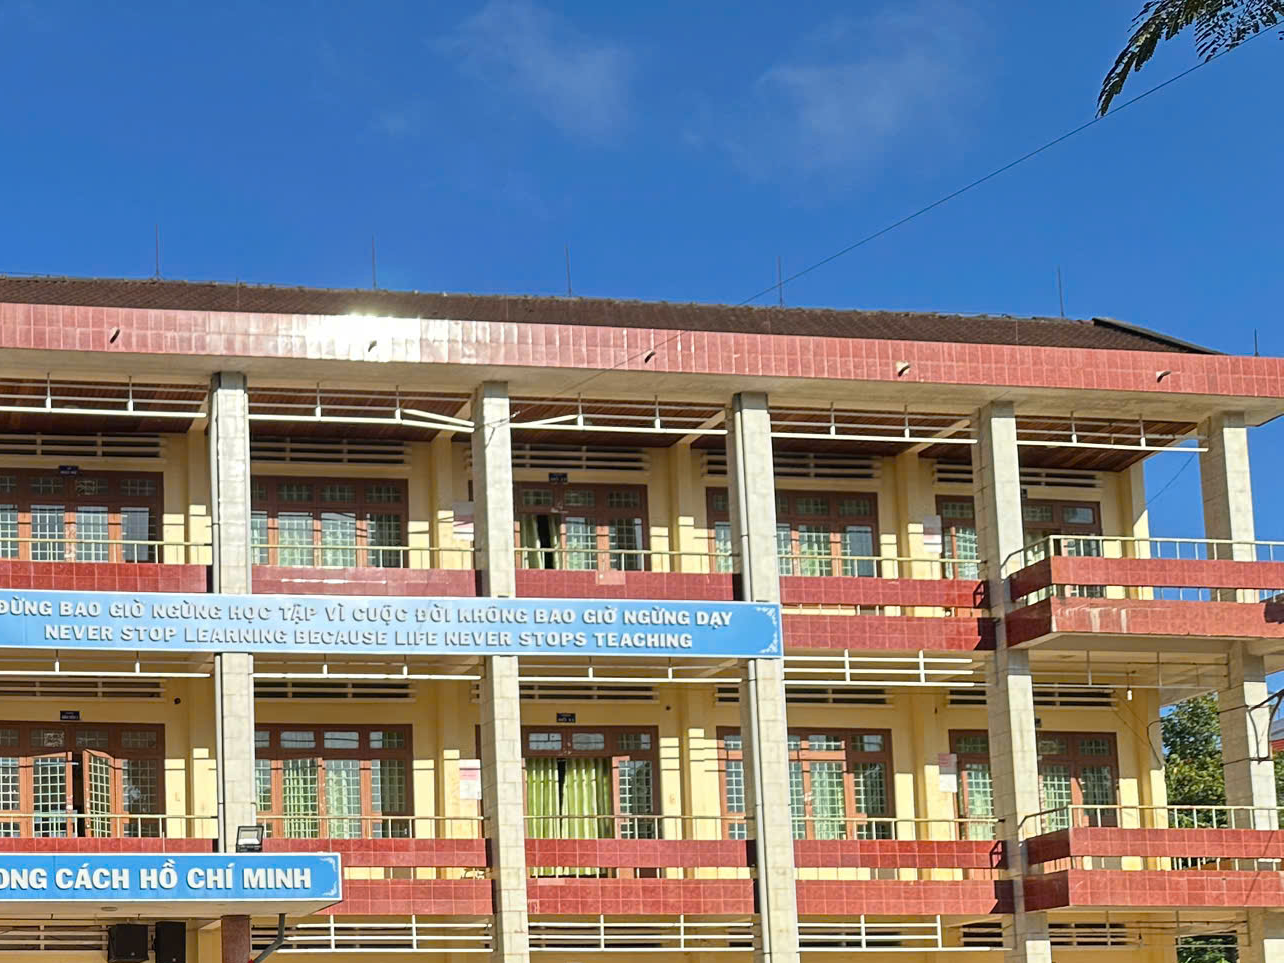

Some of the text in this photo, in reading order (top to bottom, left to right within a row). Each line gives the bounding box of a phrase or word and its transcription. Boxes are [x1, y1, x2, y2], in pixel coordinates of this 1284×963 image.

[59, 601, 101, 618] BAO
[108, 599, 146, 619] GIỜ
[151, 599, 222, 620] NGỪNG
[228, 605, 272, 624] HỌC
[279, 603, 317, 625] TẬP
[325, 602, 346, 622] VÌ
[352, 604, 408, 626] CUỘC
[415, 604, 452, 623] ĐỜI
[457, 605, 529, 624] KHÔNG
[534, 608, 576, 624] BAO
[582, 605, 618, 624] GIỜ
[622, 605, 691, 625] NGỪNG
[695, 611, 733, 630] DẠY
[44, 623, 693, 649] NEVER STOP LEARNING BECAUSE LIFE NEVER STOPS TEACHING
[55, 863, 130, 890] CÁCH
[139, 859, 178, 890] HỒ
[186, 862, 235, 890] CHÍ
[243, 867, 312, 890] MINH
